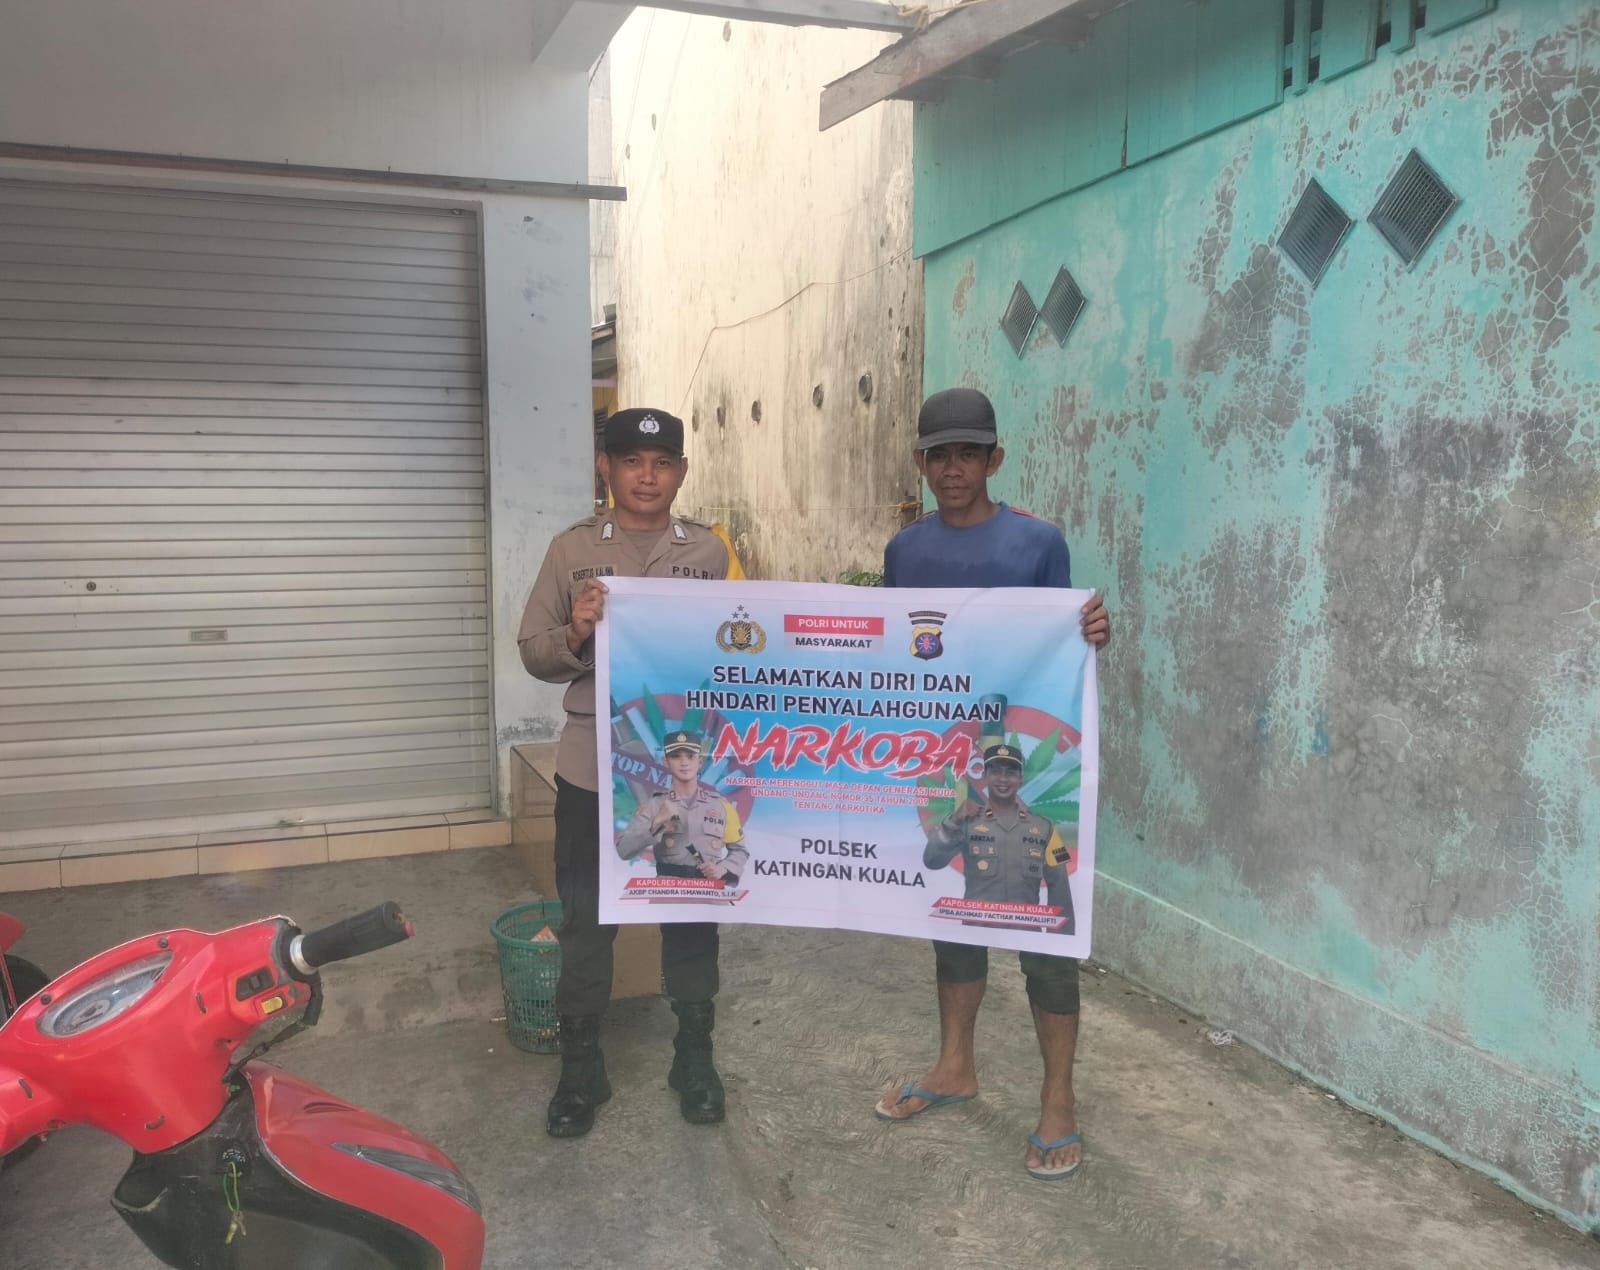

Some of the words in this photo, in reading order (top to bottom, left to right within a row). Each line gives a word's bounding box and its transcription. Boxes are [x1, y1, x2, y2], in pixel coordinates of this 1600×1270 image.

[672, 566, 714, 580] POLRI
[798, 618, 829, 629] POLRI
[831, 620, 869, 631] UNTUK
[795, 637, 872, 649] MASYARAKAT
[713, 666, 863, 690] SELAMATKAN
[870, 671, 915, 692] DIRI
[923, 675, 971, 694] DAN
[687, 691, 776, 712] HINDARI
[783, 696, 1001, 721] PENYALAHGUNAAN
[712, 718, 973, 780] NARKOBA
[725, 777, 767, 786] NARKOBA
[769, 778, 822, 788] MERENGGUT
[825, 781, 849, 790] MASA
[851, 783, 881, 792] DEPAN
[883, 785, 928, 795] GENERASI
[929, 788, 957, 798] MUDA
[751, 788, 827, 799] UNDANG-UNDANG
[829, 792, 861, 802] NOMOR
[877, 796, 906, 805] TAHUN
[793, 801, 833, 809] TENTANG
[835, 802, 885, 814] NARKOTIKA
[801, 838, 877, 859] POLSEK
[754, 859, 852, 881] KATINGAN
[858, 867, 926, 888] KUALA
[636, 879, 675, 887] KAPOLRES
[940, 898, 982, 909] KAPOLSEK
[983, 903, 1024, 912] KATINGAN
[1026, 905, 1054, 914] KUALA
